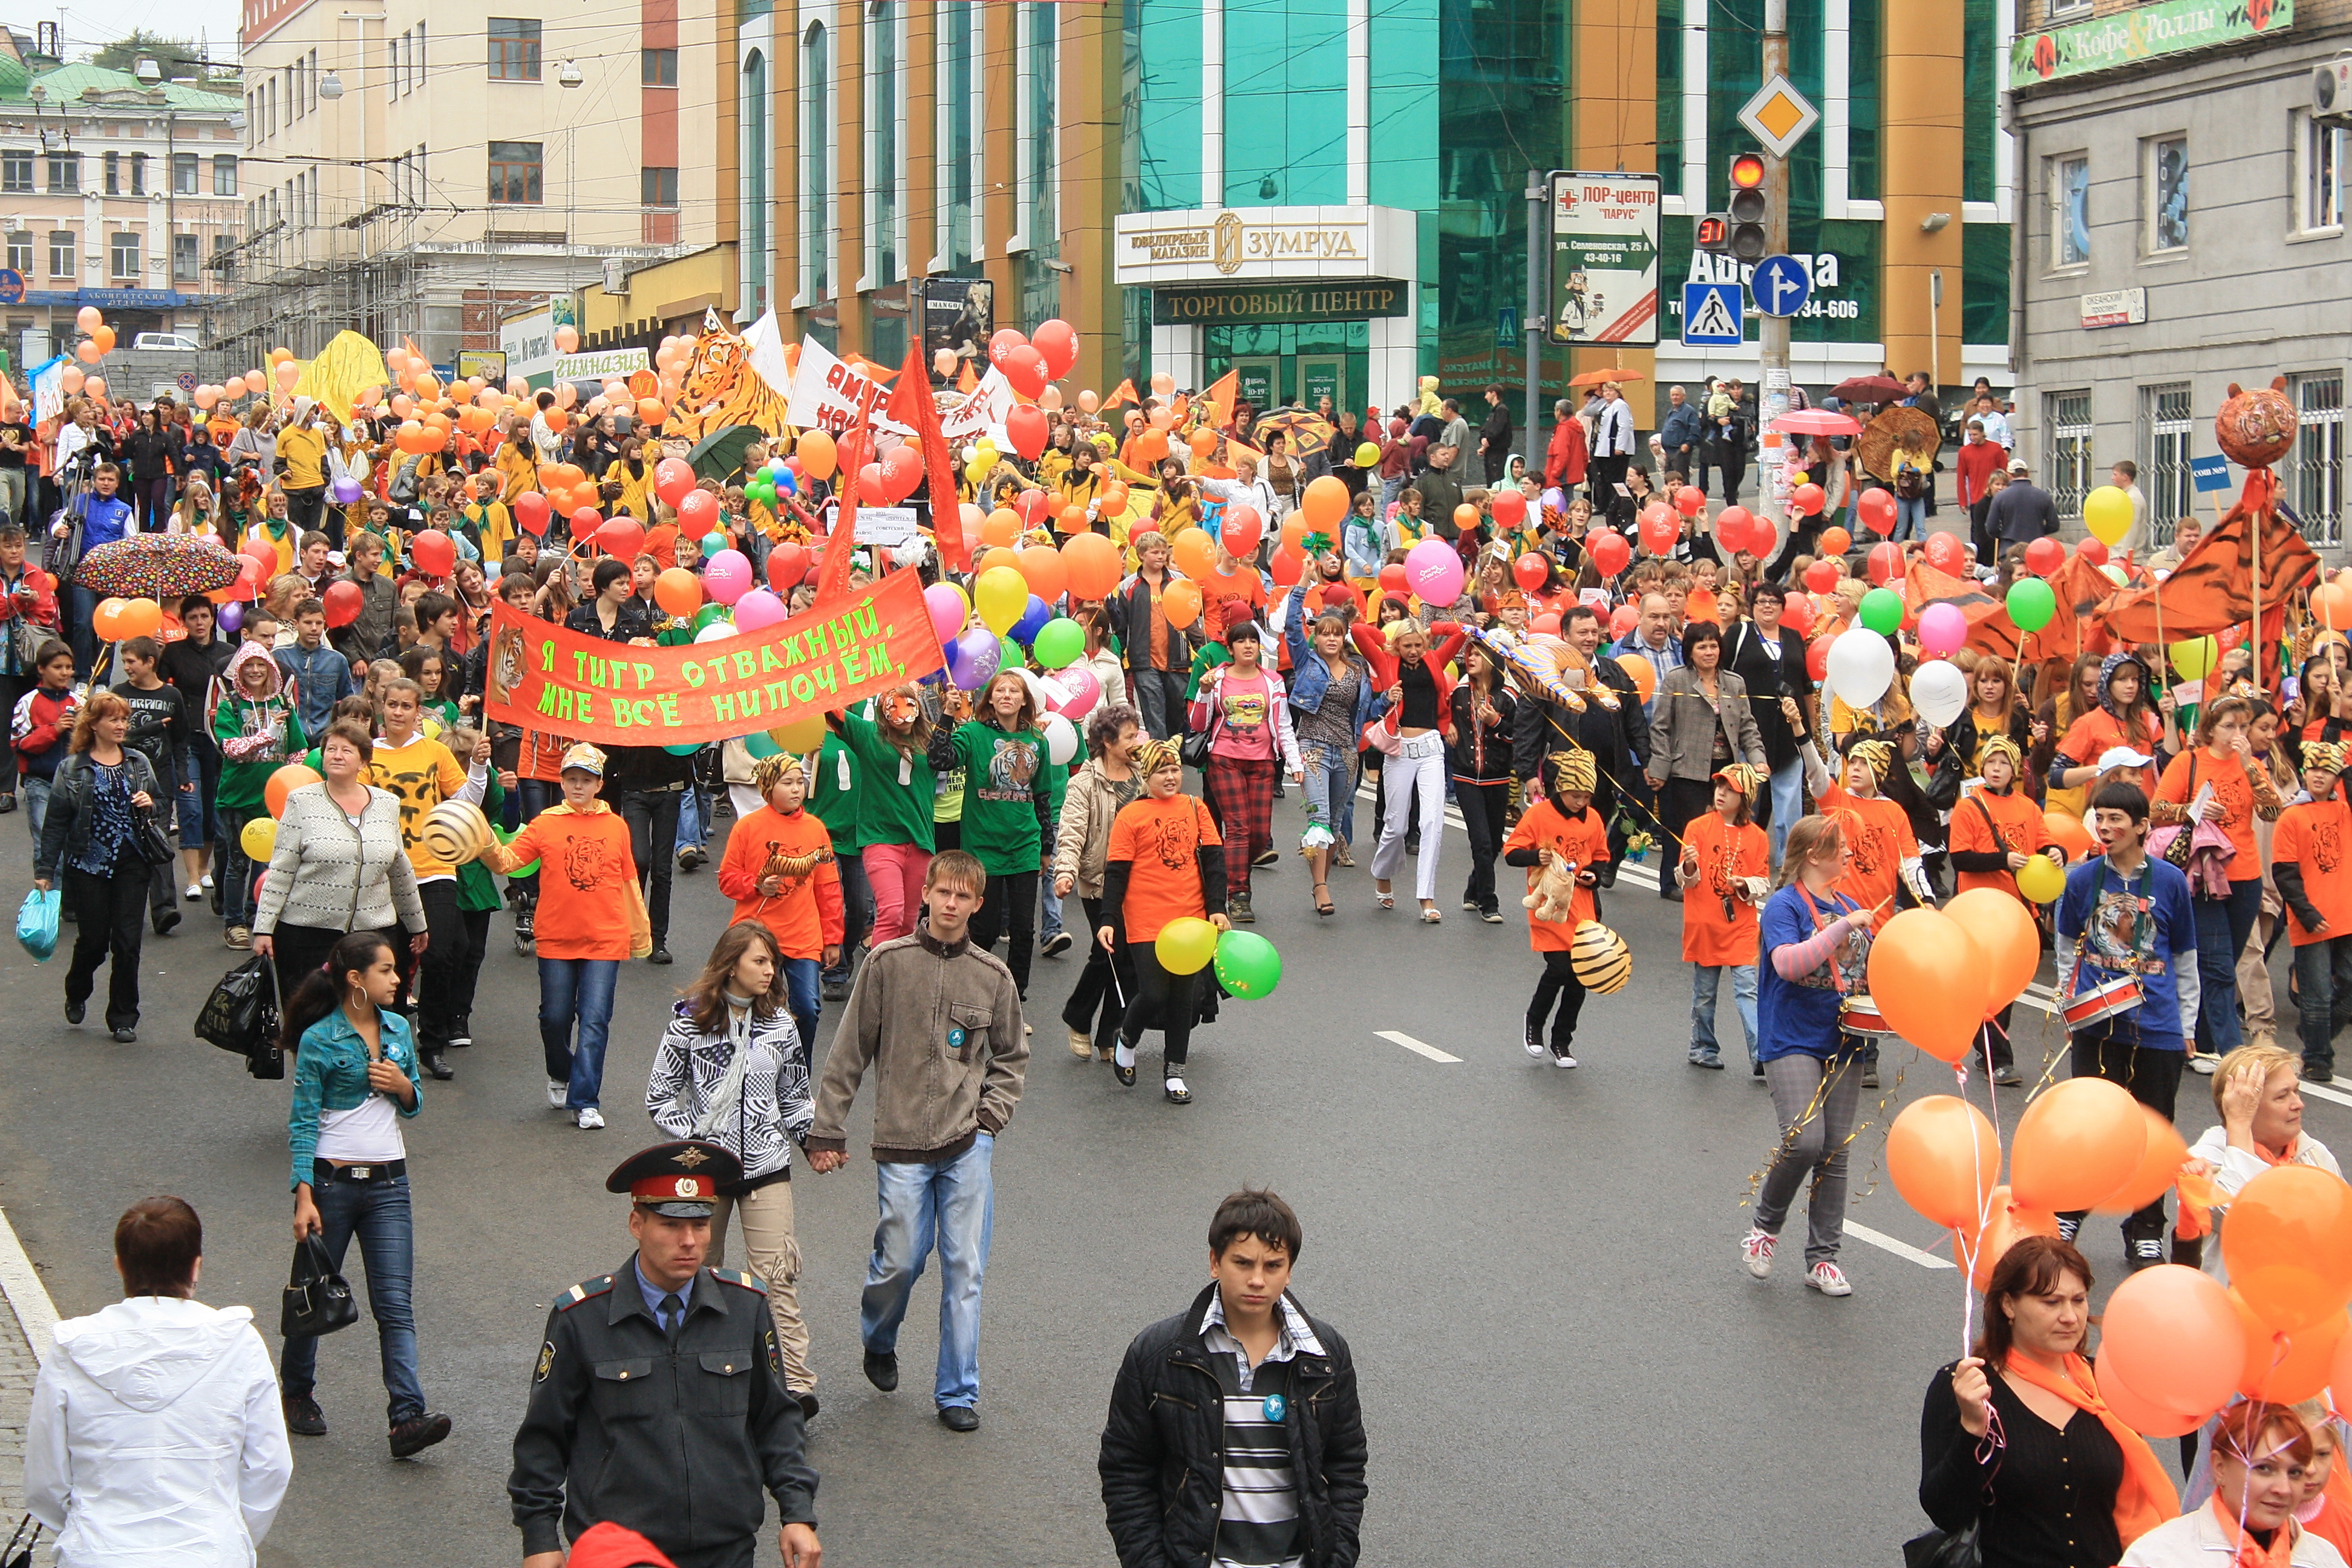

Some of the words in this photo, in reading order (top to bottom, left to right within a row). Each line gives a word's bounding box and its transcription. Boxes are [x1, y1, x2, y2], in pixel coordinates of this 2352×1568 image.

[1583, 186, 1656, 206] ЛОР-центр
[1599, 208, 1640, 220] "ПАРУС"
[1131, 230, 1210, 249] ЮВЕЛИРНЫЙ
[1699, 221, 1724, 243] 31
[1151, 244, 1210, 259] МАГАЗИН
[1556, 242, 1569, 251] ул.
[1630, 243, 1642, 251] 25
[1584, 253, 1622, 263] 43-40-16
[1169, 289, 1304, 318] ТОРГОВЫЙ
[1310, 289, 1394, 316] ЦЕНТР
[555, 351, 648, 379] гимназия
[541, 639, 555, 673] Я
[573, 650, 656, 690] ТИГР
[681, 596, 893, 689] ОТВАЖНЫЙ,
[537, 681, 595, 725] МНЕ
[610, 692, 683, 728] ВСЁ
[711, 641, 906, 722] НИПОЧЁМ,
